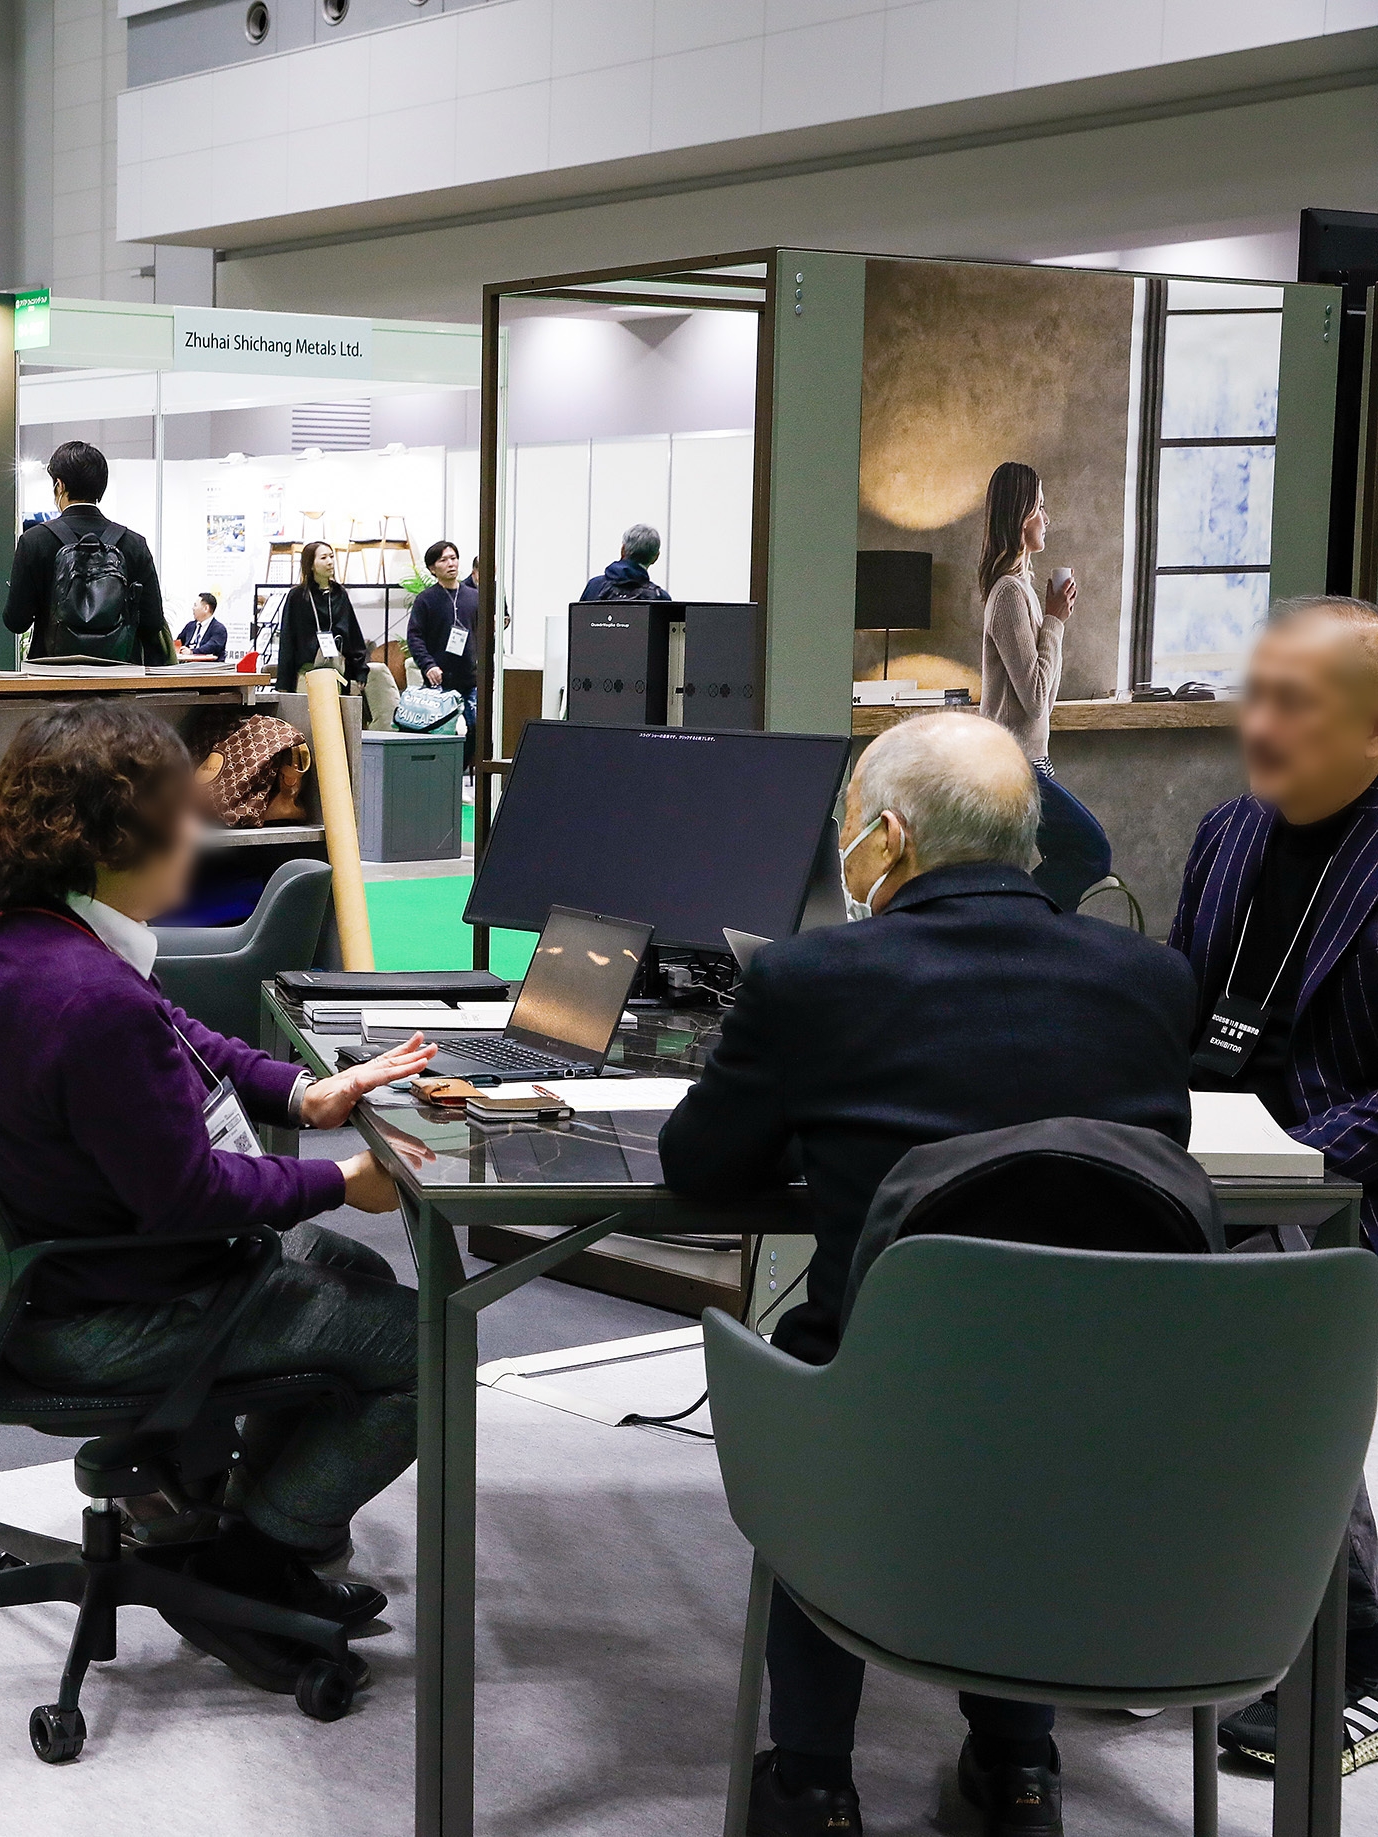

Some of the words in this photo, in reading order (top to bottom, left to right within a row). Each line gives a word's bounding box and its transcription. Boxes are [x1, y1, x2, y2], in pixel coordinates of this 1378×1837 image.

[185, 331, 230, 350] Zhuhai
[233, 334, 292, 357] Shichang
[295, 338, 337, 356] Metals
[340, 340, 363, 357] Ltd.
[1209, 1036, 1243, 1054] EXHIBITOR
